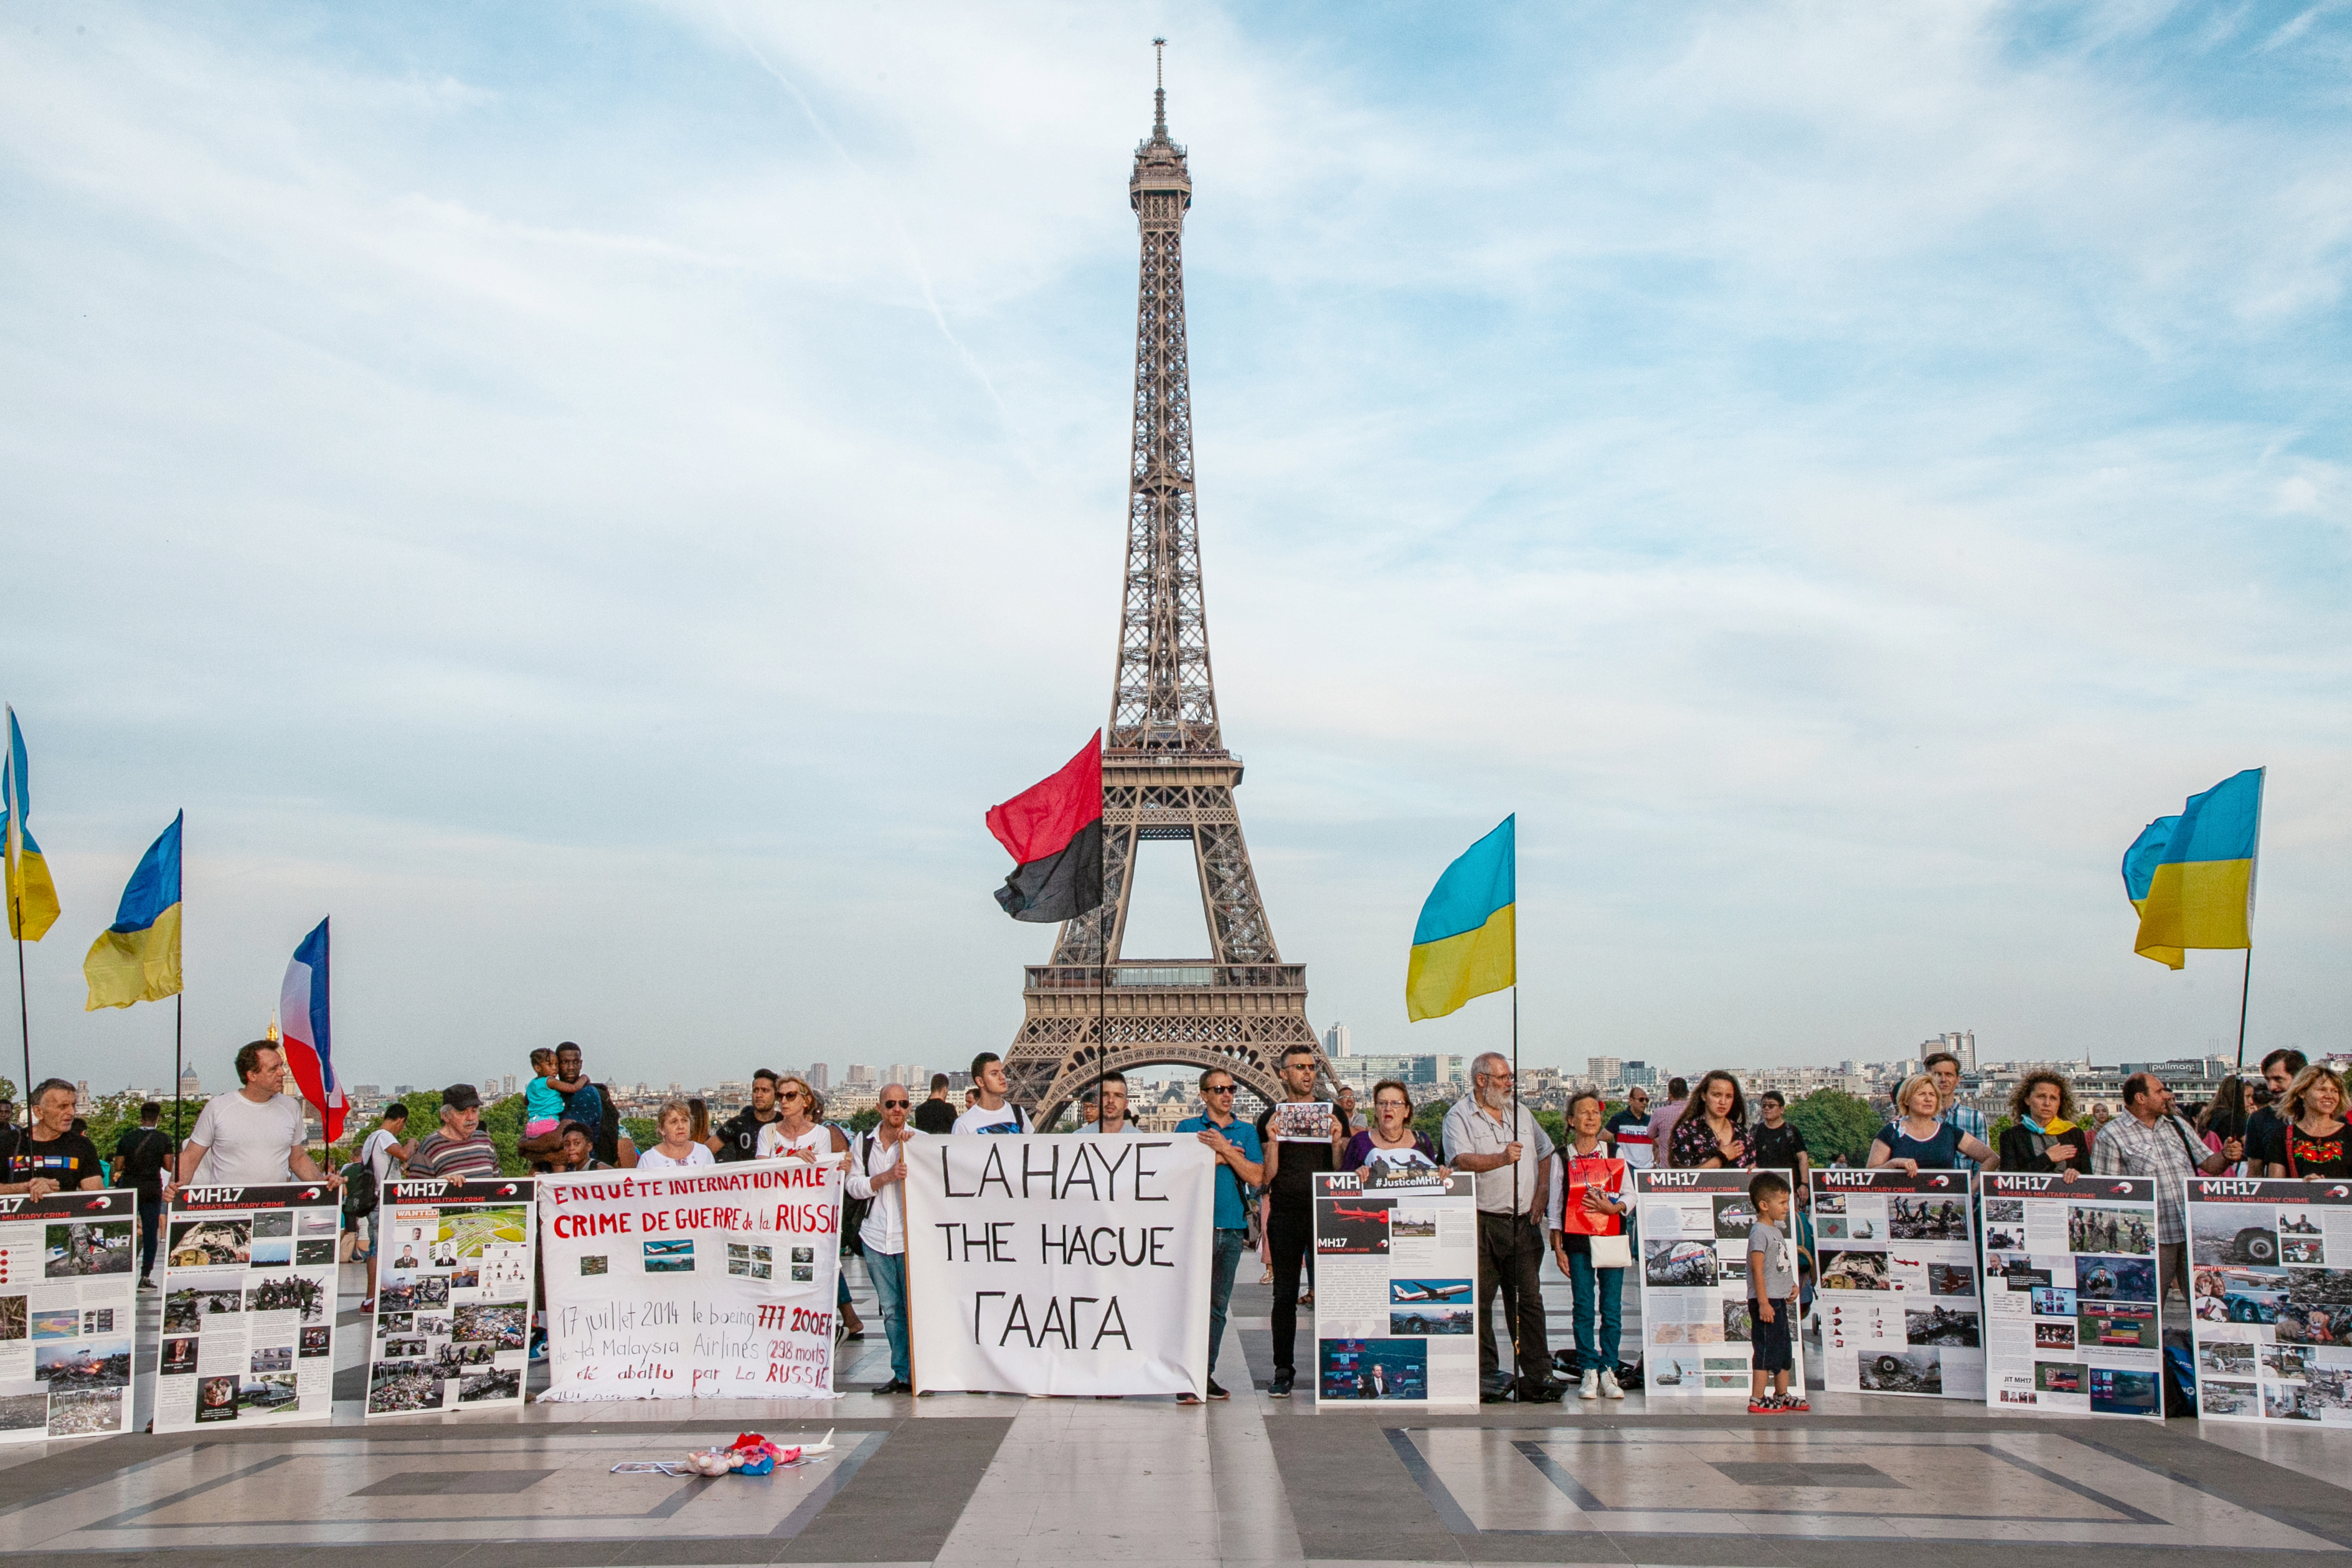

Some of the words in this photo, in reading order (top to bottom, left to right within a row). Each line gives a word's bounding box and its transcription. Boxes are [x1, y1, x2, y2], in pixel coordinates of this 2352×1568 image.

[2152, 1063, 2191, 1072] pullman
[1022, 1142, 1173, 1201] HAYE
[1650, 1173, 1701, 1186] MH17
[1825, 1172, 1876, 1186] MH17
[397, 1183, 449, 1197] MH17
[554, 1176, 663, 1205] ENQUÊTE
[669, 1167, 828, 1195] INTERNATIONALE
[1998, 1176, 2052, 1191] MH17
[2203, 1181, 2262, 1195] MH17
[187, 1188, 245, 1203] MH17
[554, 1212, 631, 1239] CRIME
[642, 1211, 670, 1232] DE
[675, 1206, 742, 1231] GUERRE
[742, 1211, 752, 1230] de
[759, 1208, 770, 1231] la
[935, 1221, 1017, 1262] THE
[1041, 1223, 1174, 1267] HAGUE
[1318, 1238, 1348, 1248] MH17
[558, 1306, 578, 1338] 17
[586, 1301, 636, 1345] juillet
[641, 1301, 679, 1326] 2014
[693, 1301, 702, 1324] le
[711, 1302, 755, 1341] boeing
[757, 1305, 786, 1331] 777
[975, 1291, 1133, 1350] ГААГА
[555, 1346, 569, 1364] de
[603, 1336, 679, 1367] Malaysia
[693, 1330, 759, 1359] Airlines
[577, 1365, 598, 1380] été
[618, 1363, 674, 1380] abattu
[692, 1368, 721, 1392] par
[765, 1363, 829, 1389] RUSSIE
